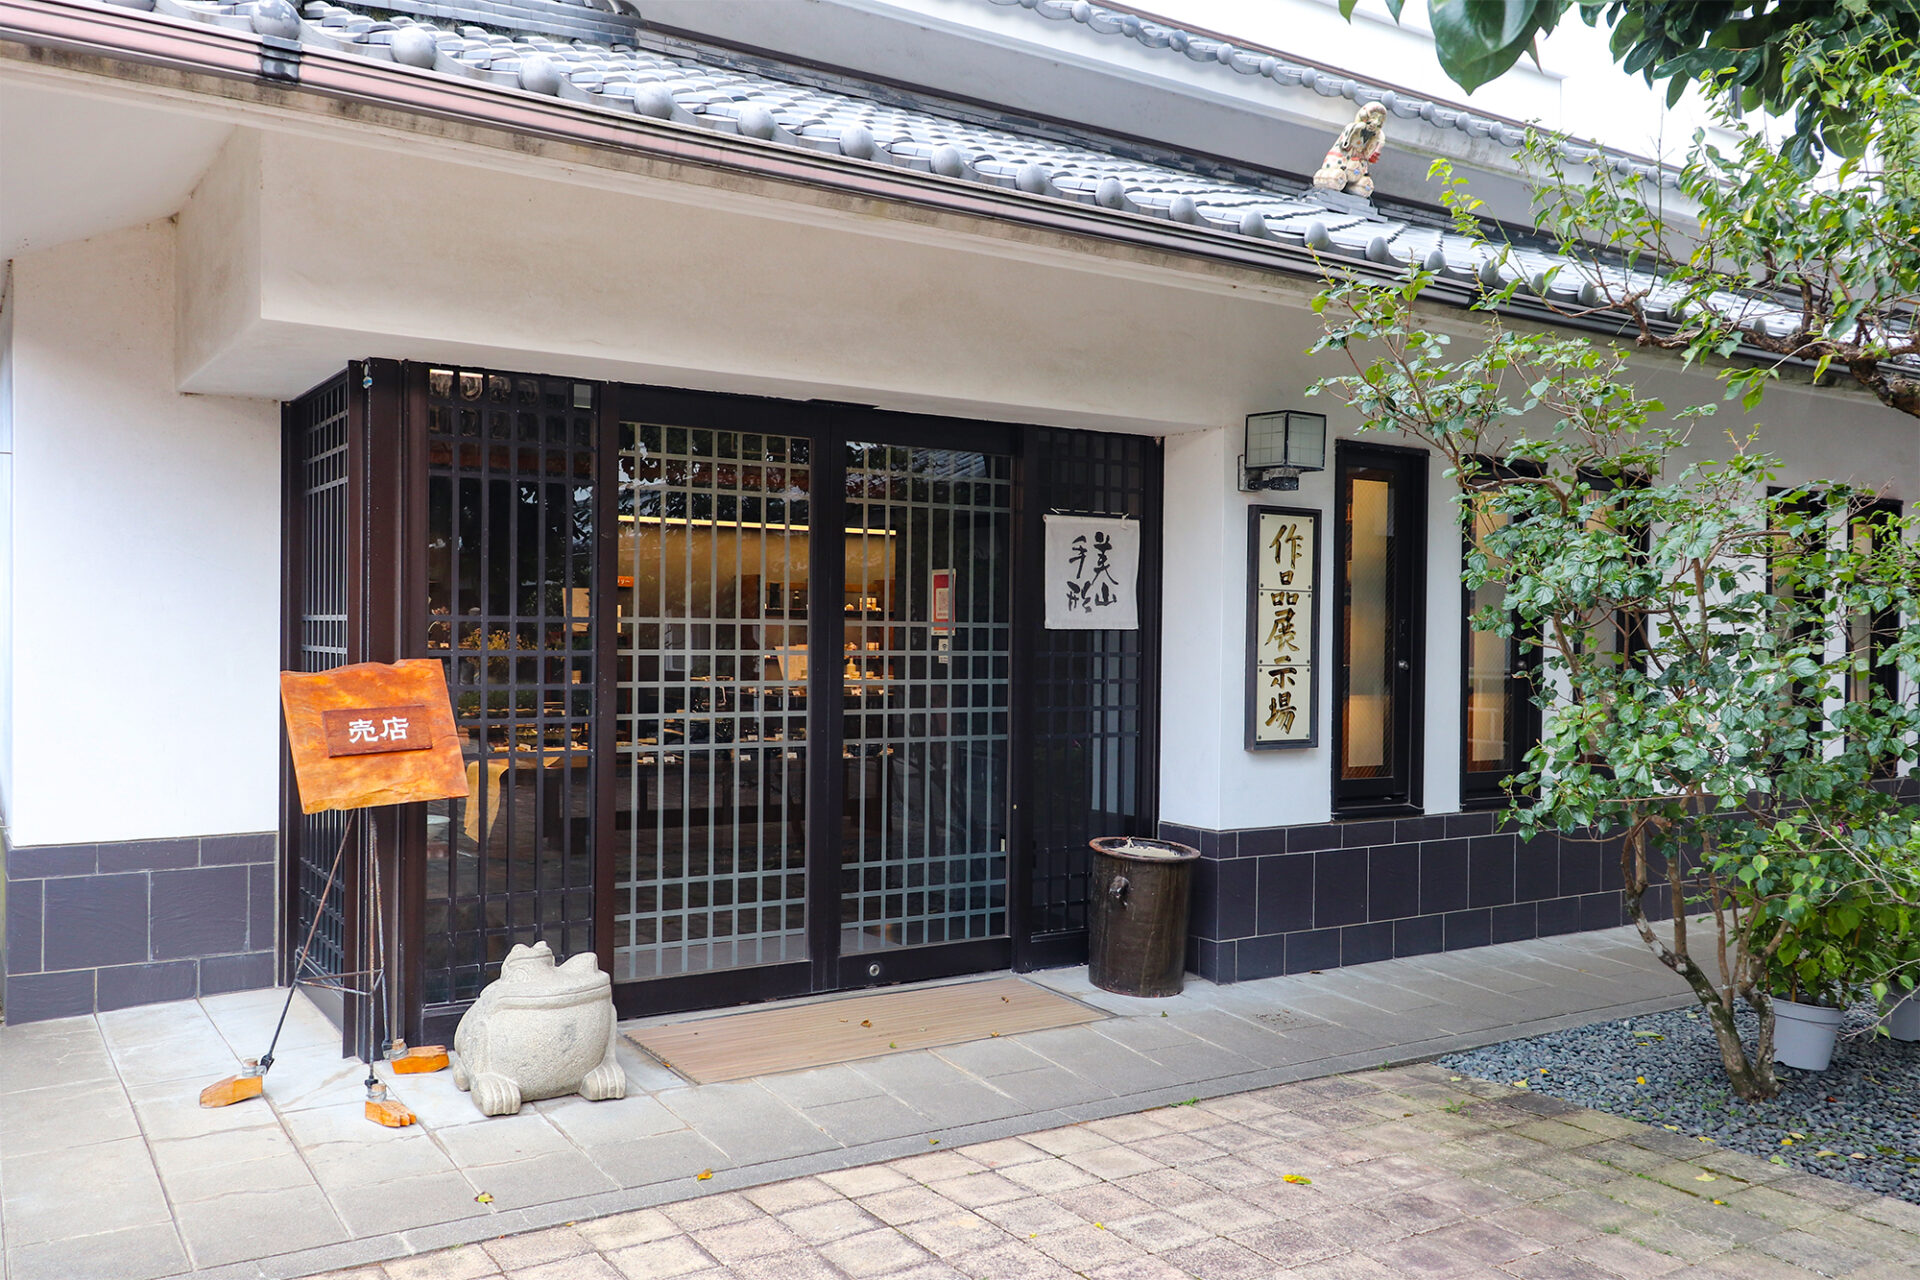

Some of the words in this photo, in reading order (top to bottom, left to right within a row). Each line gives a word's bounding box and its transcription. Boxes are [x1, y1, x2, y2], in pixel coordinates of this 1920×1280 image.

[1091, 531, 1119, 607] 美山
[1263, 523, 1304, 735] 作品展示場
[348, 716, 410, 744] 売店
